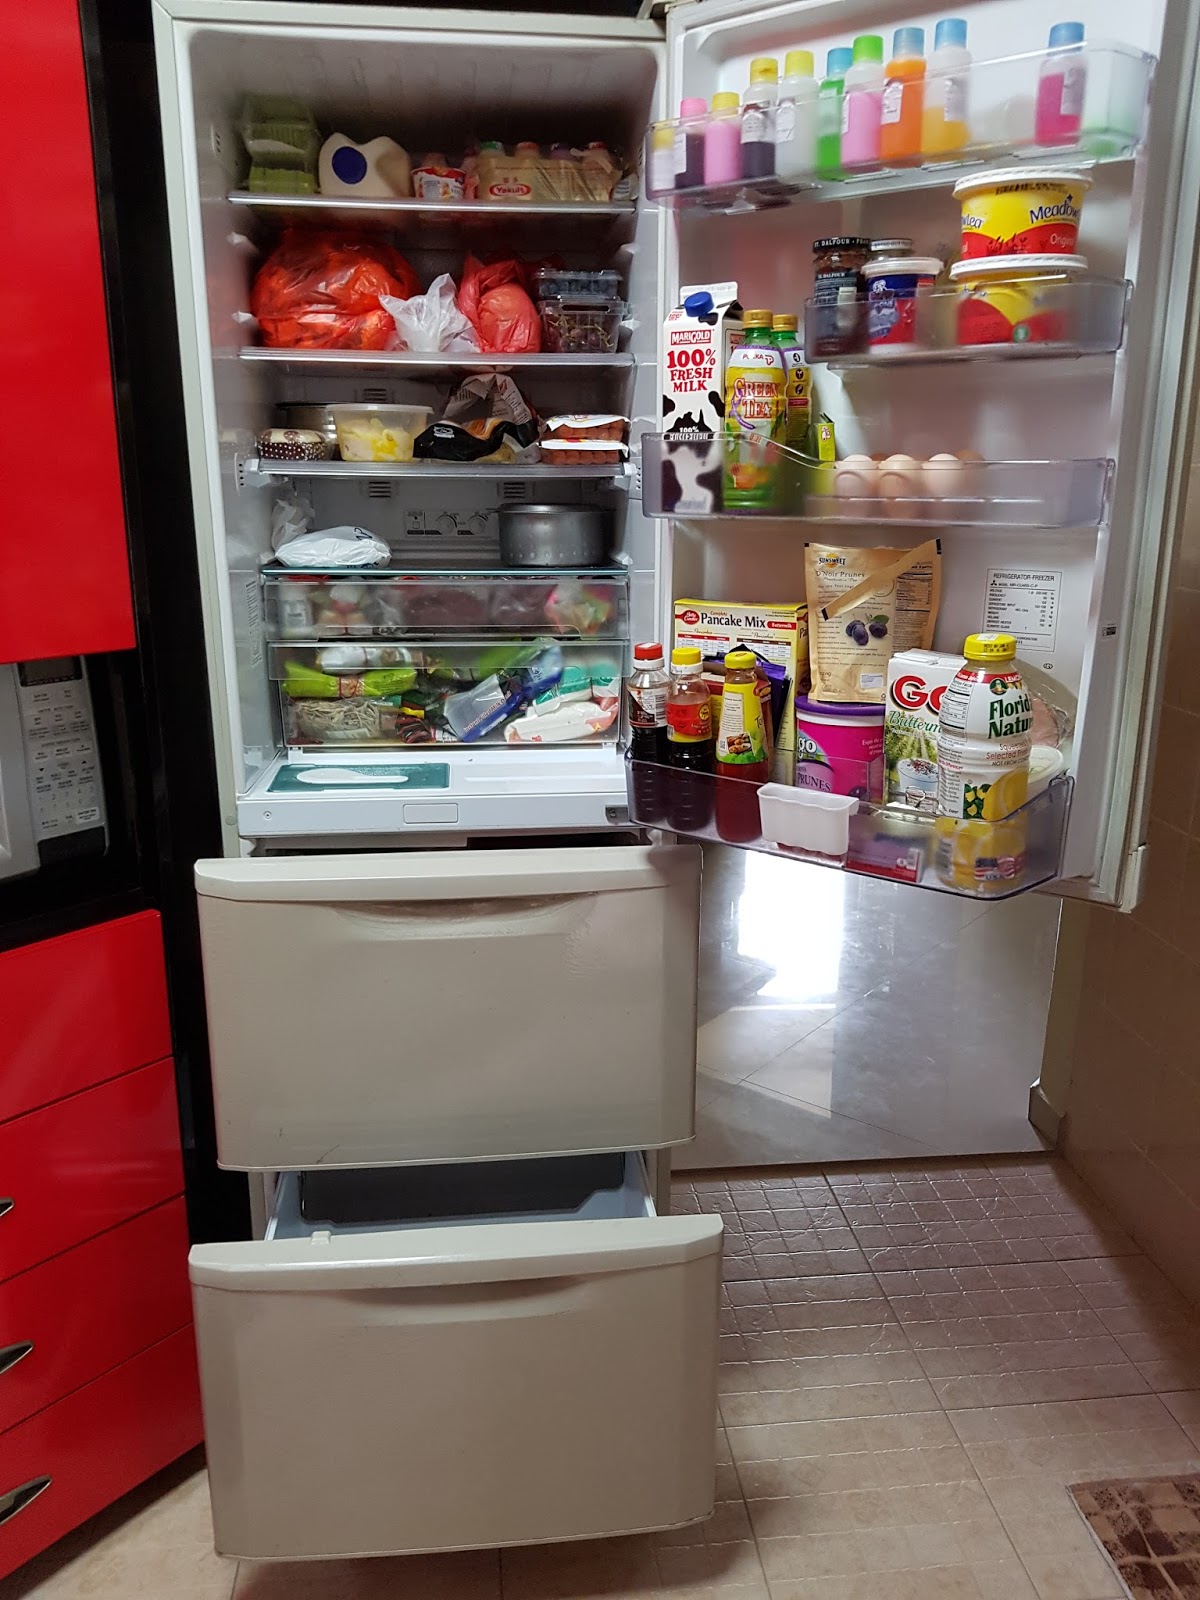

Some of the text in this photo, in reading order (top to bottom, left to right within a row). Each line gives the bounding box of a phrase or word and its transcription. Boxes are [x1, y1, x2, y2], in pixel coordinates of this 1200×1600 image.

[821, 238, 850, 246] DALFOUR
[671, 331, 711, 344] MARIGOLD
[667, 348, 716, 368] 100%
[670, 367, 713, 381] FRESH
[673, 380, 707, 392] MILK
[734, 378, 779, 399] GREEN
[742, 398, 772, 419] TEA
[818, 557, 846, 565] SUNSWEET
[701, 612, 742, 627] Pancake
[744, 616, 766, 628] Mix
[989, 694, 1032, 720] Florid
